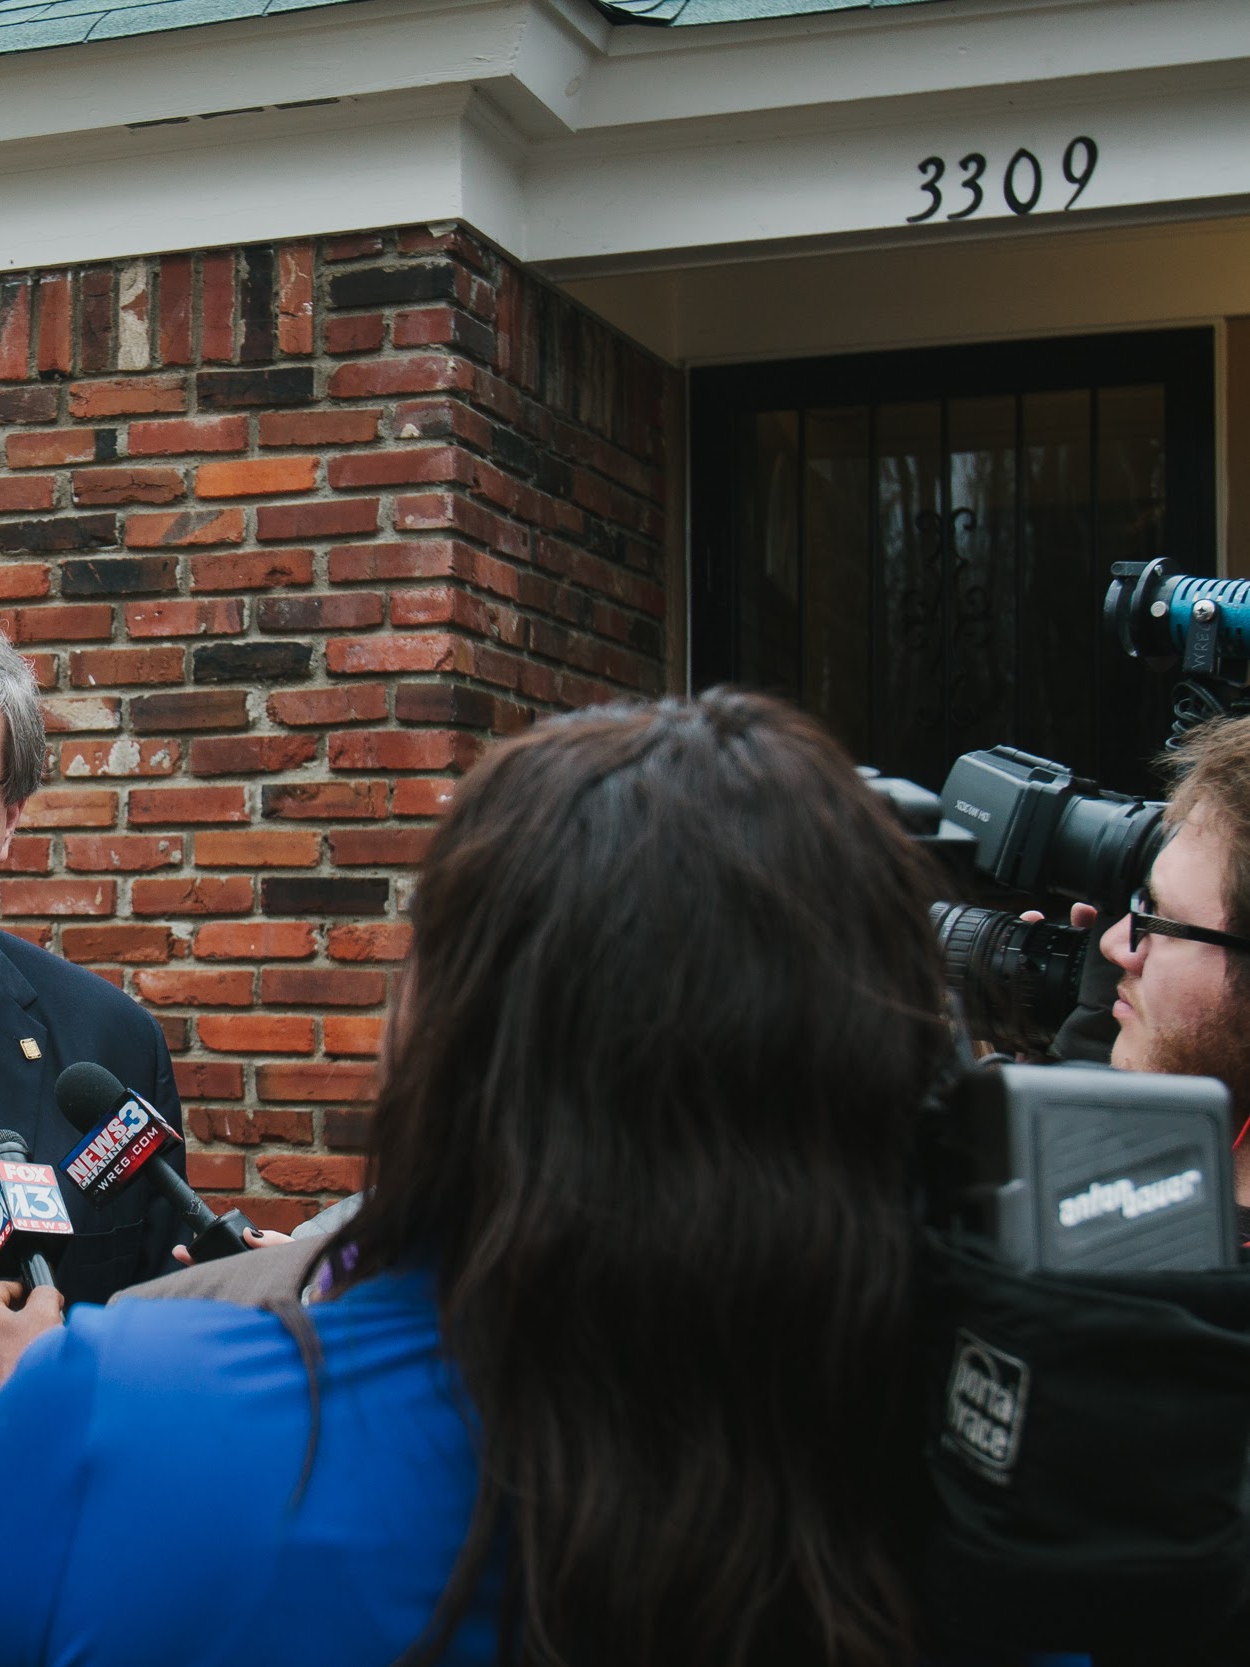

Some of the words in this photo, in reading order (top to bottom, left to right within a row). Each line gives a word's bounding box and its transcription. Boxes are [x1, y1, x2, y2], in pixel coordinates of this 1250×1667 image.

[906, 135, 1099, 223] 3309
[66, 1118, 128, 1184] NEWS
[119, 1100, 149, 1134] 3
[79, 1131, 135, 1190] CHANNEL
[98, 1127, 159, 1190] WREG.COM
[3, 1163, 50, 1184] FOX
[10, 1183, 58, 1219] 13
[17, 1220, 68, 1230] NEWS
